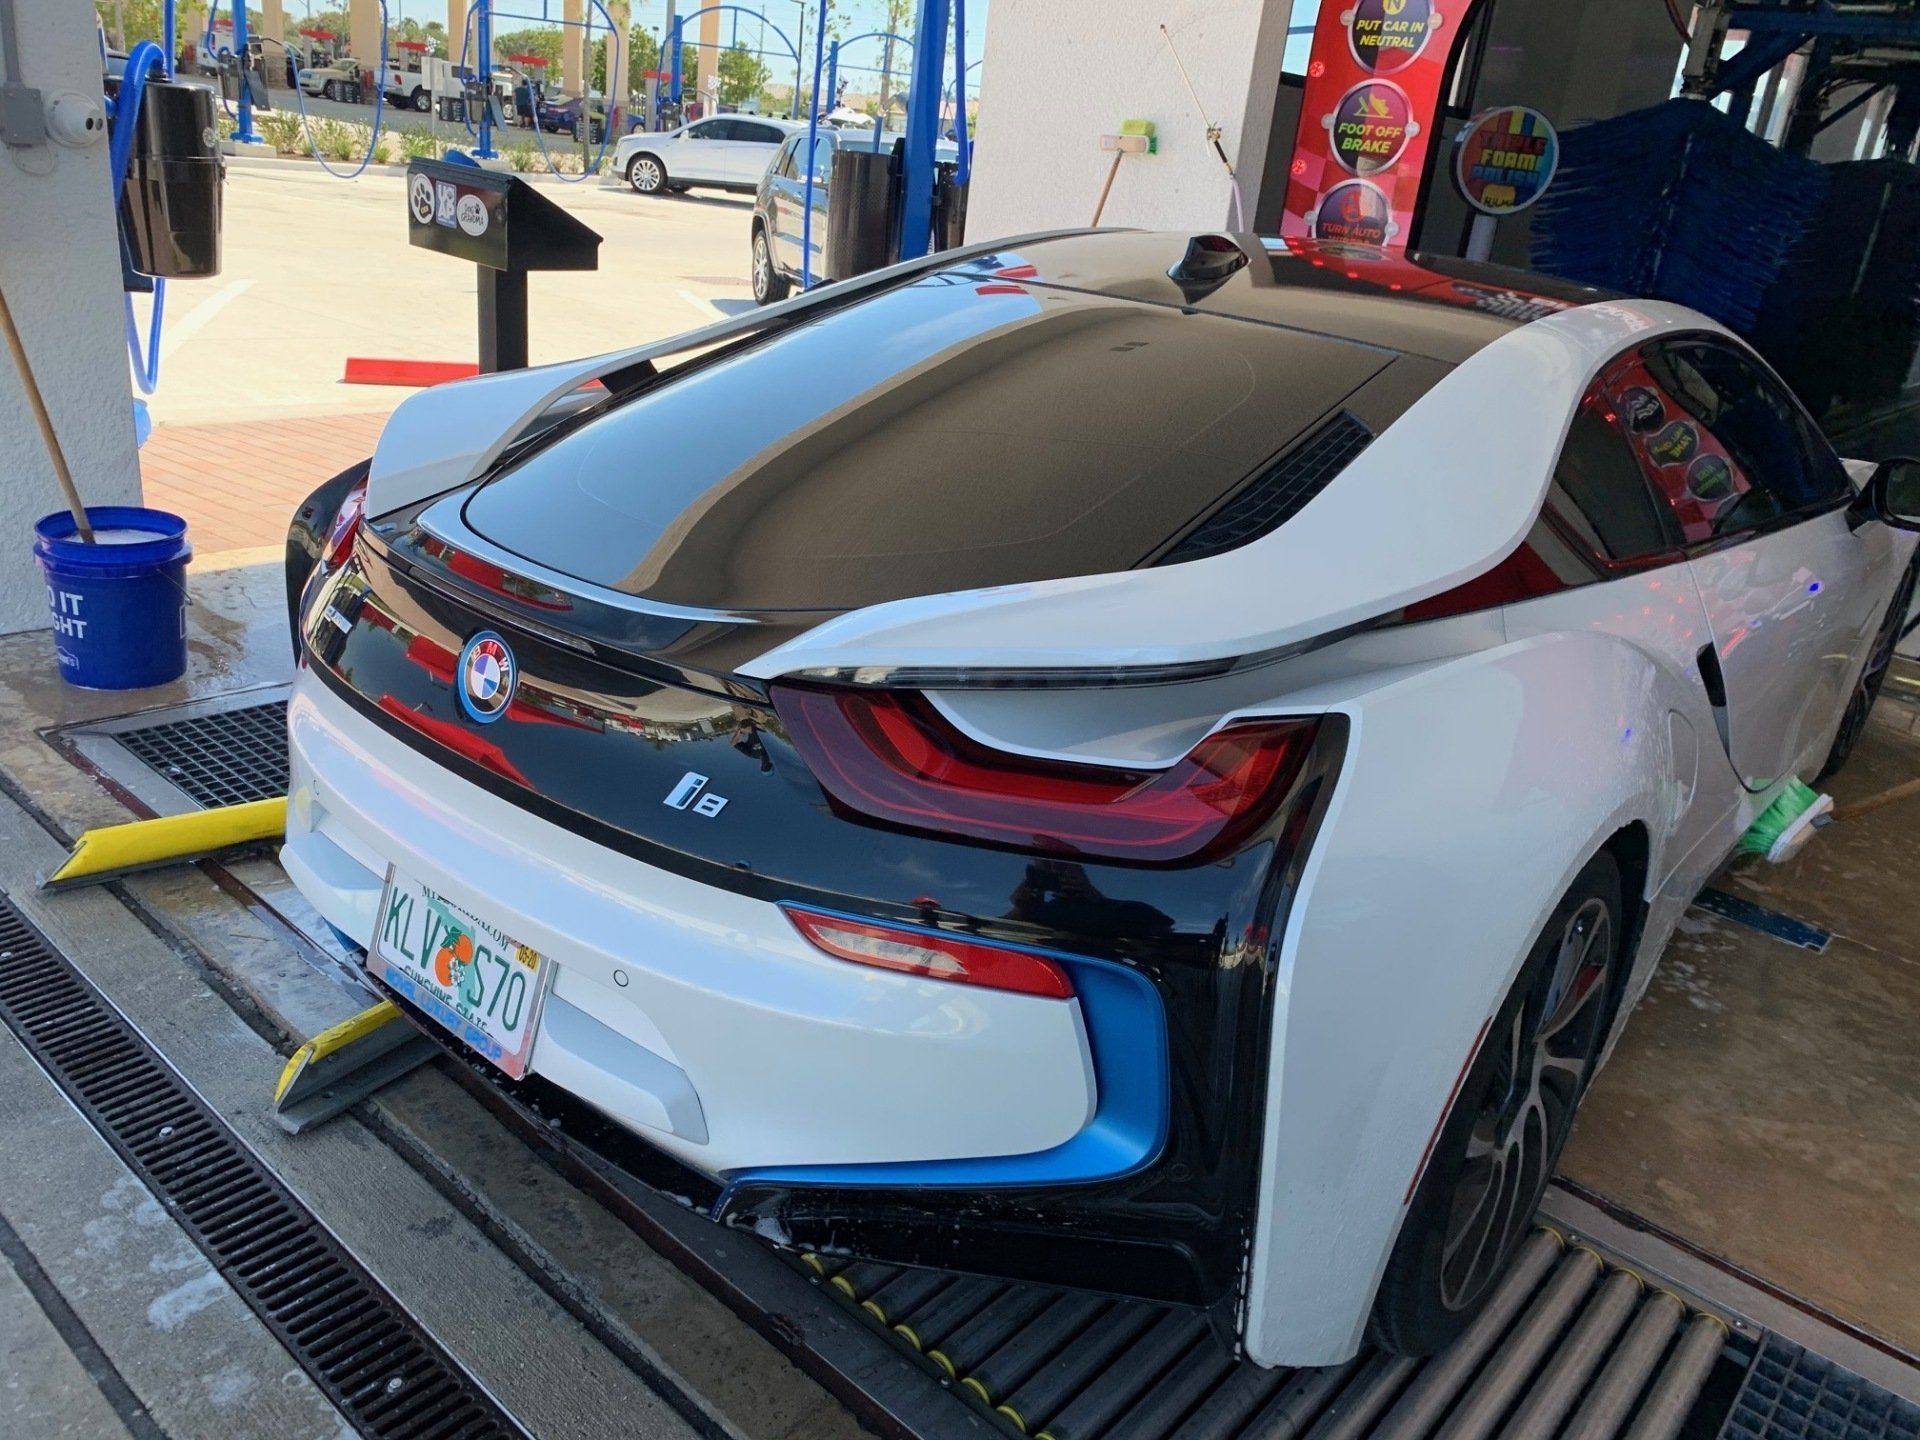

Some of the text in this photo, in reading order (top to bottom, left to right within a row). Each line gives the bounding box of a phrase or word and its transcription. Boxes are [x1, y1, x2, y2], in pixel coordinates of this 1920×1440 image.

[1356, 20, 1425, 33] PUT CAR IN
[1359, 35, 1414, 48] NEUTRAL
[1338, 123, 1403, 138] FOOT OFF
[1341, 138, 1392, 154] BRAKE
[1480, 148, 1537, 171] FOAM
[1322, 222, 1350, 235] TURN
[1351, 226, 1382, 239] AUTO
[60, 591, 83, 616] IT
[470, 641, 510, 672] BMW
[663, 771, 729, 818] i8
[383, 886, 442, 970] KLV
[467, 944, 527, 1032] S70
